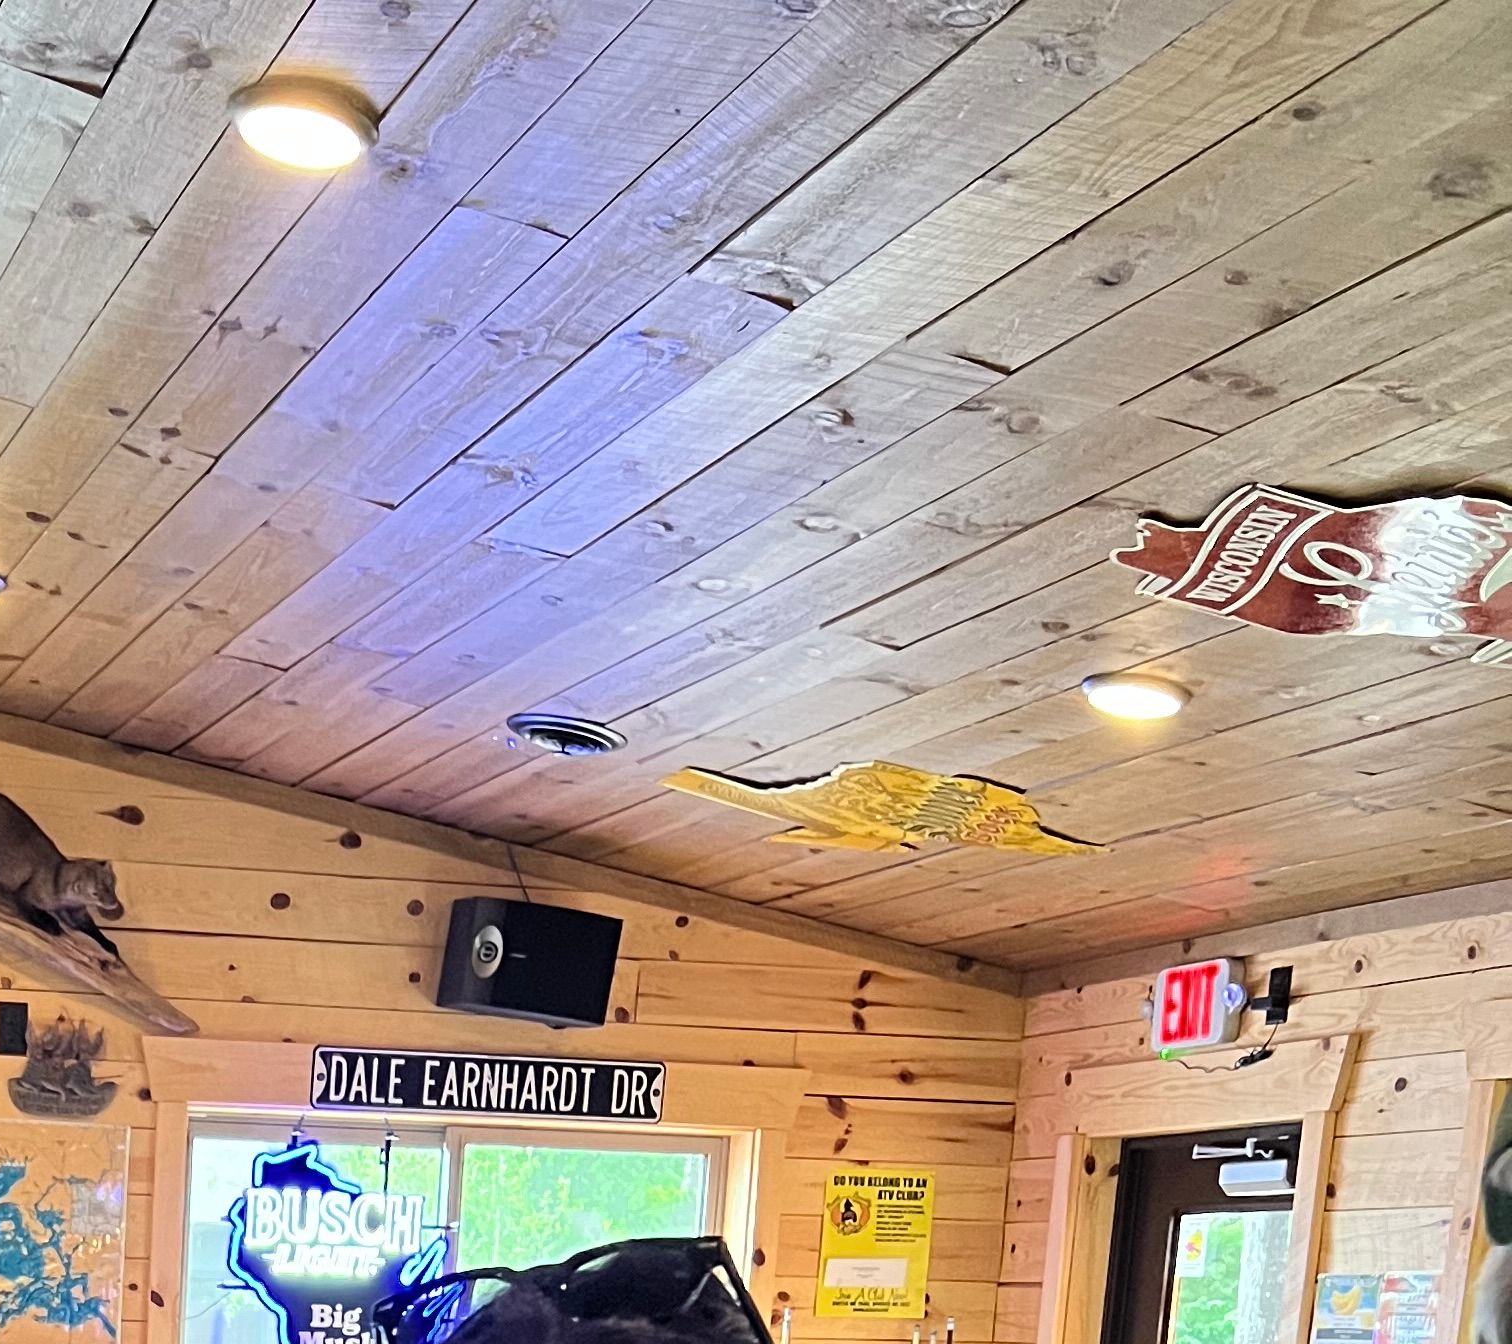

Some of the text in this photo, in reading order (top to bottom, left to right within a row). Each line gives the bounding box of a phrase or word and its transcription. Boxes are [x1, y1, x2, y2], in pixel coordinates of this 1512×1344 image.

[1186, 504, 1298, 602] WISCONSIN
[1161, 964, 1220, 1044] EXIT
[329, 1055, 649, 1115] DALE EARNHARDT DR
[834, 1175, 928, 1188] DO YOU BELONG TO AN
[877, 1190, 925, 1201] ATV CLUB?
[244, 1187, 426, 1254] BUSCH
[310, 1303, 363, 1336] Big
